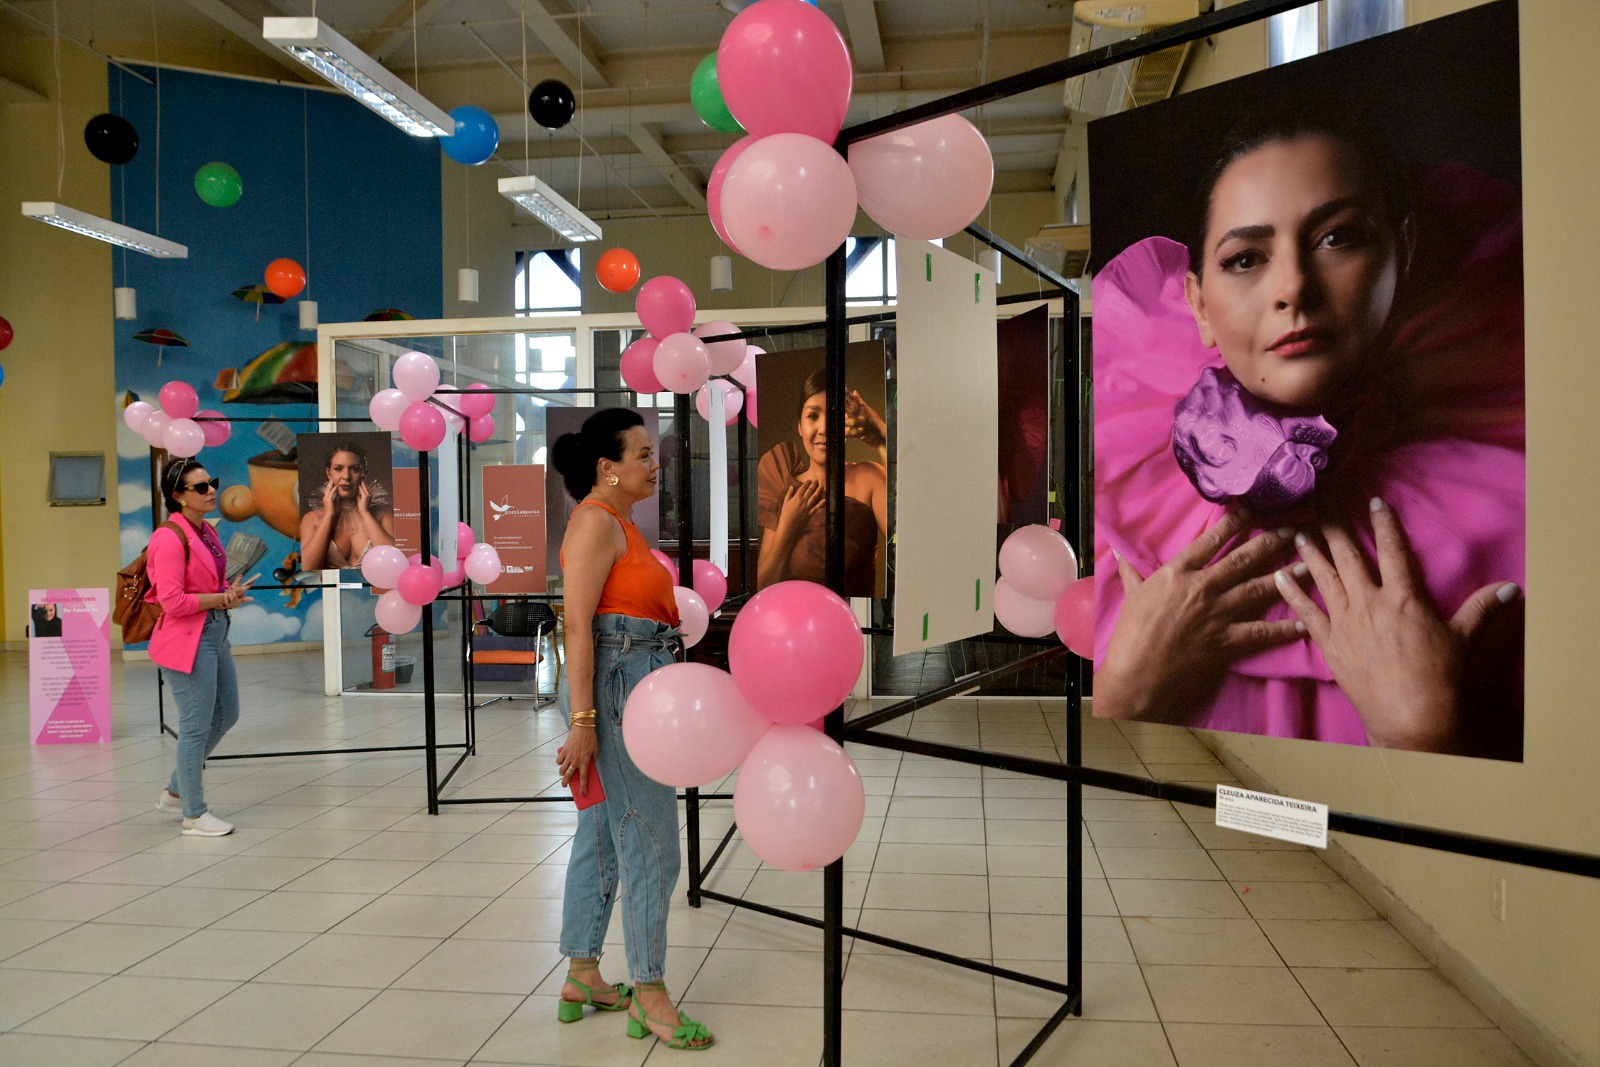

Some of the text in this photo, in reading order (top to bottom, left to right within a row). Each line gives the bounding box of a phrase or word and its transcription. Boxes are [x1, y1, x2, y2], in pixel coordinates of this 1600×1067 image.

[1218, 788, 1318, 813] CLEUZA APARECIDA TEIXEIRA
